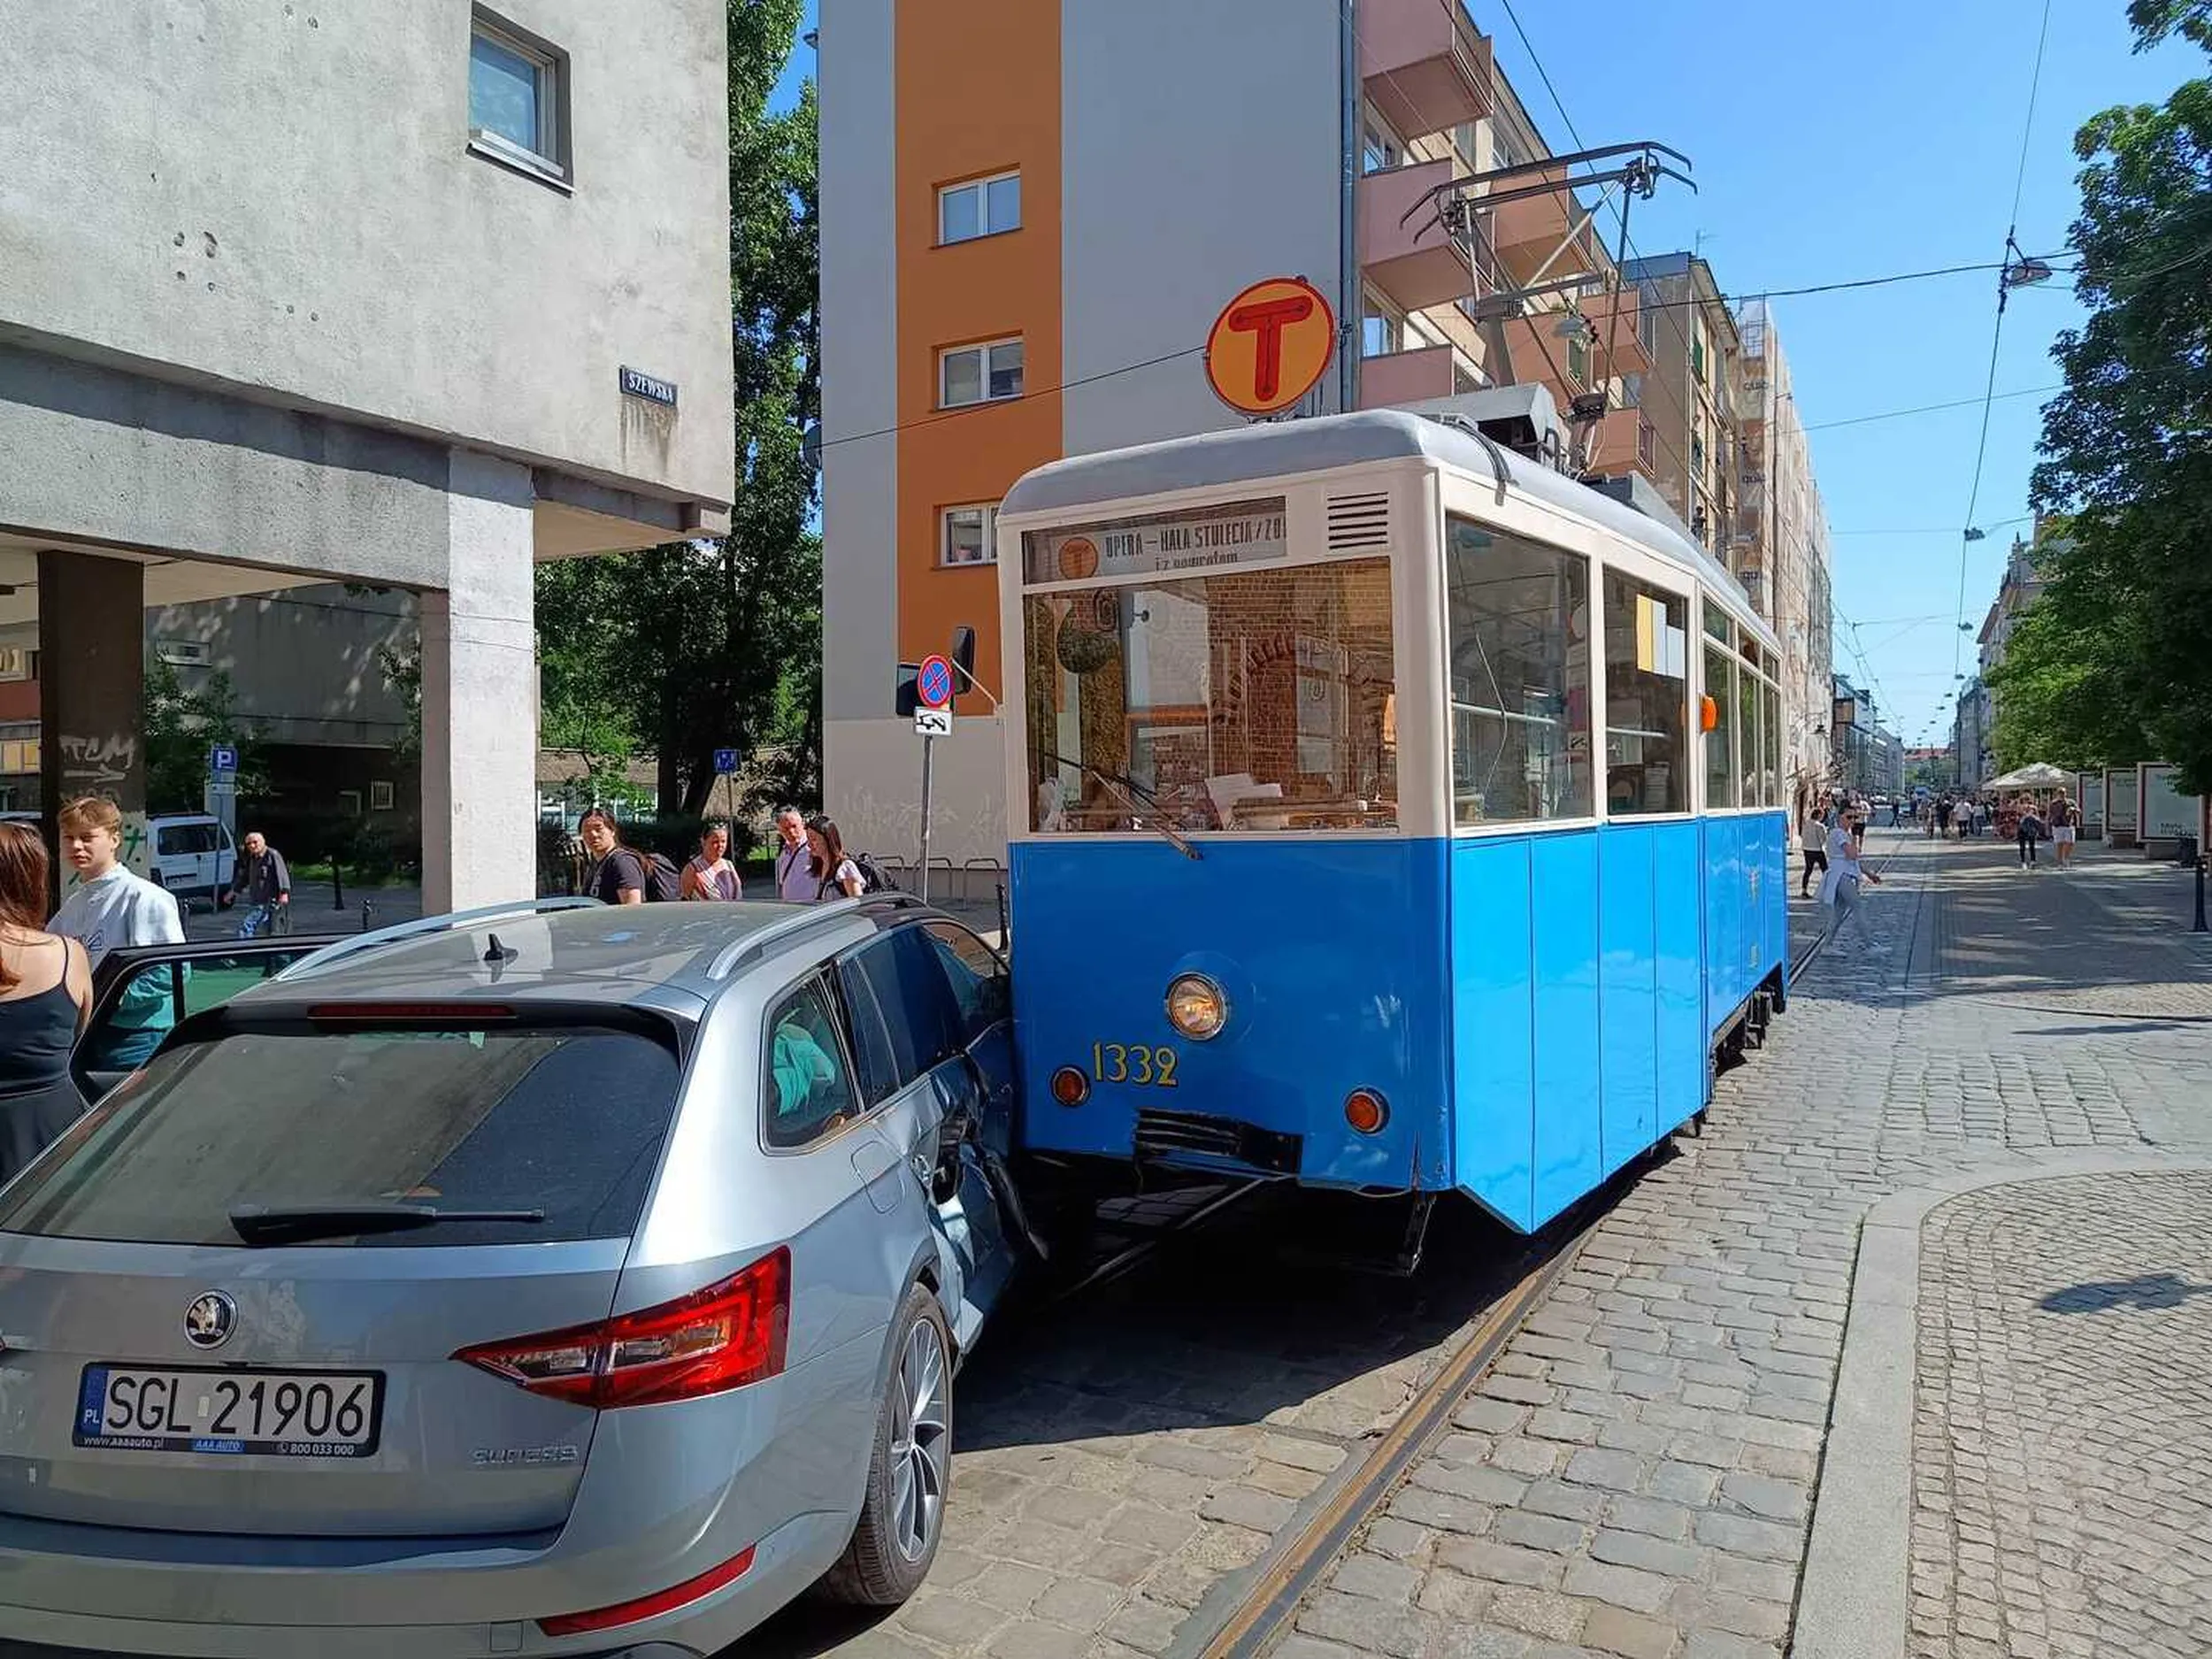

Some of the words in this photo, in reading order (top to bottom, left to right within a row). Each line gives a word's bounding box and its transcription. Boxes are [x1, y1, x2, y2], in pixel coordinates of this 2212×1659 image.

[1228, 294, 1314, 403] T
[628, 372, 673, 403] SZEWSKA
[1160, 527, 1191, 552] HALA
[217, 750, 232, 769] P
[1093, 1041, 1179, 1087] 1332
[83, 1409, 100, 1424] PL
[107, 1376, 191, 1432] SGL
[211, 1379, 365, 1437] 21906
[195, 1440, 215, 1451] AAA
[216, 1440, 241, 1452] AUTO
[289, 1443, 311, 1455] 800
[312, 1444, 332, 1455] 033
[334, 1444, 354, 1455] 000
